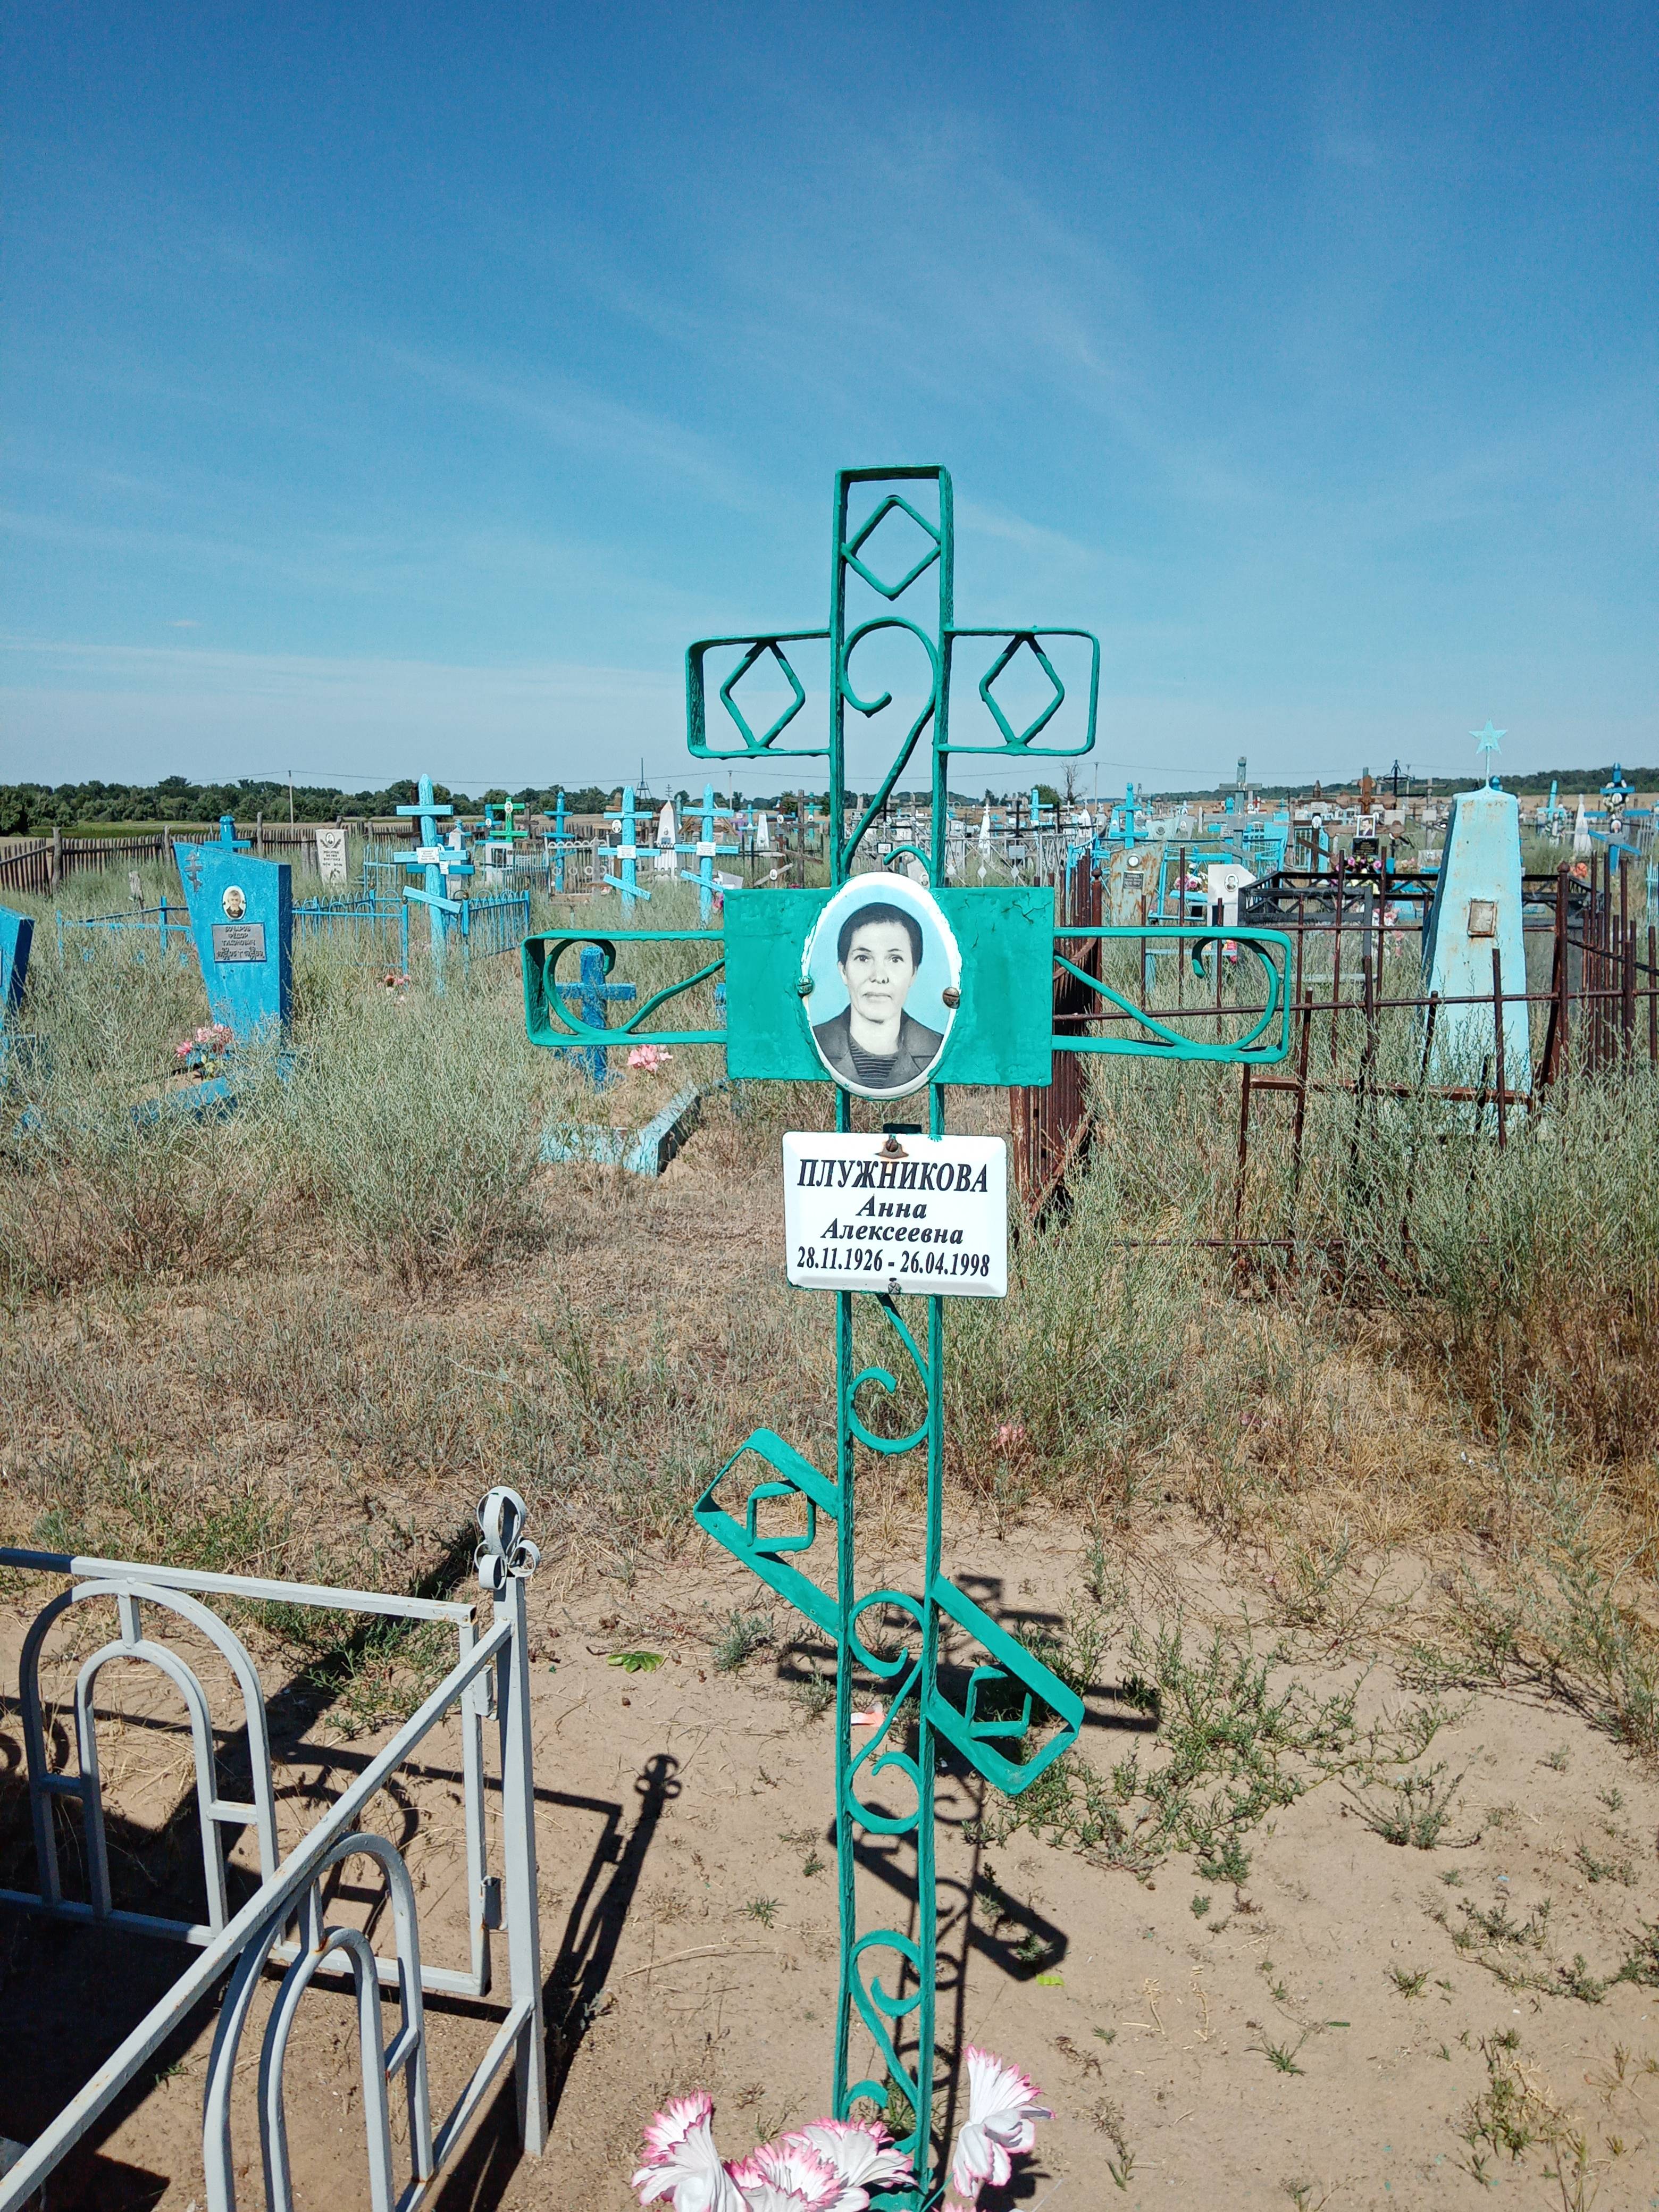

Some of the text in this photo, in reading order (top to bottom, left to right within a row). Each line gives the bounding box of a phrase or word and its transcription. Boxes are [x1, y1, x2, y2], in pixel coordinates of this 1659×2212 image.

[797, 1159, 988, 1192] ПЛУЖНИКОВА
[855, 1195, 927, 1219] Анна
[820, 1218, 963, 1245] Алексеевна
[797, 1246, 883, 1271] 28.11.1926
[900, 1250, 990, 1277] 26.04.1998
